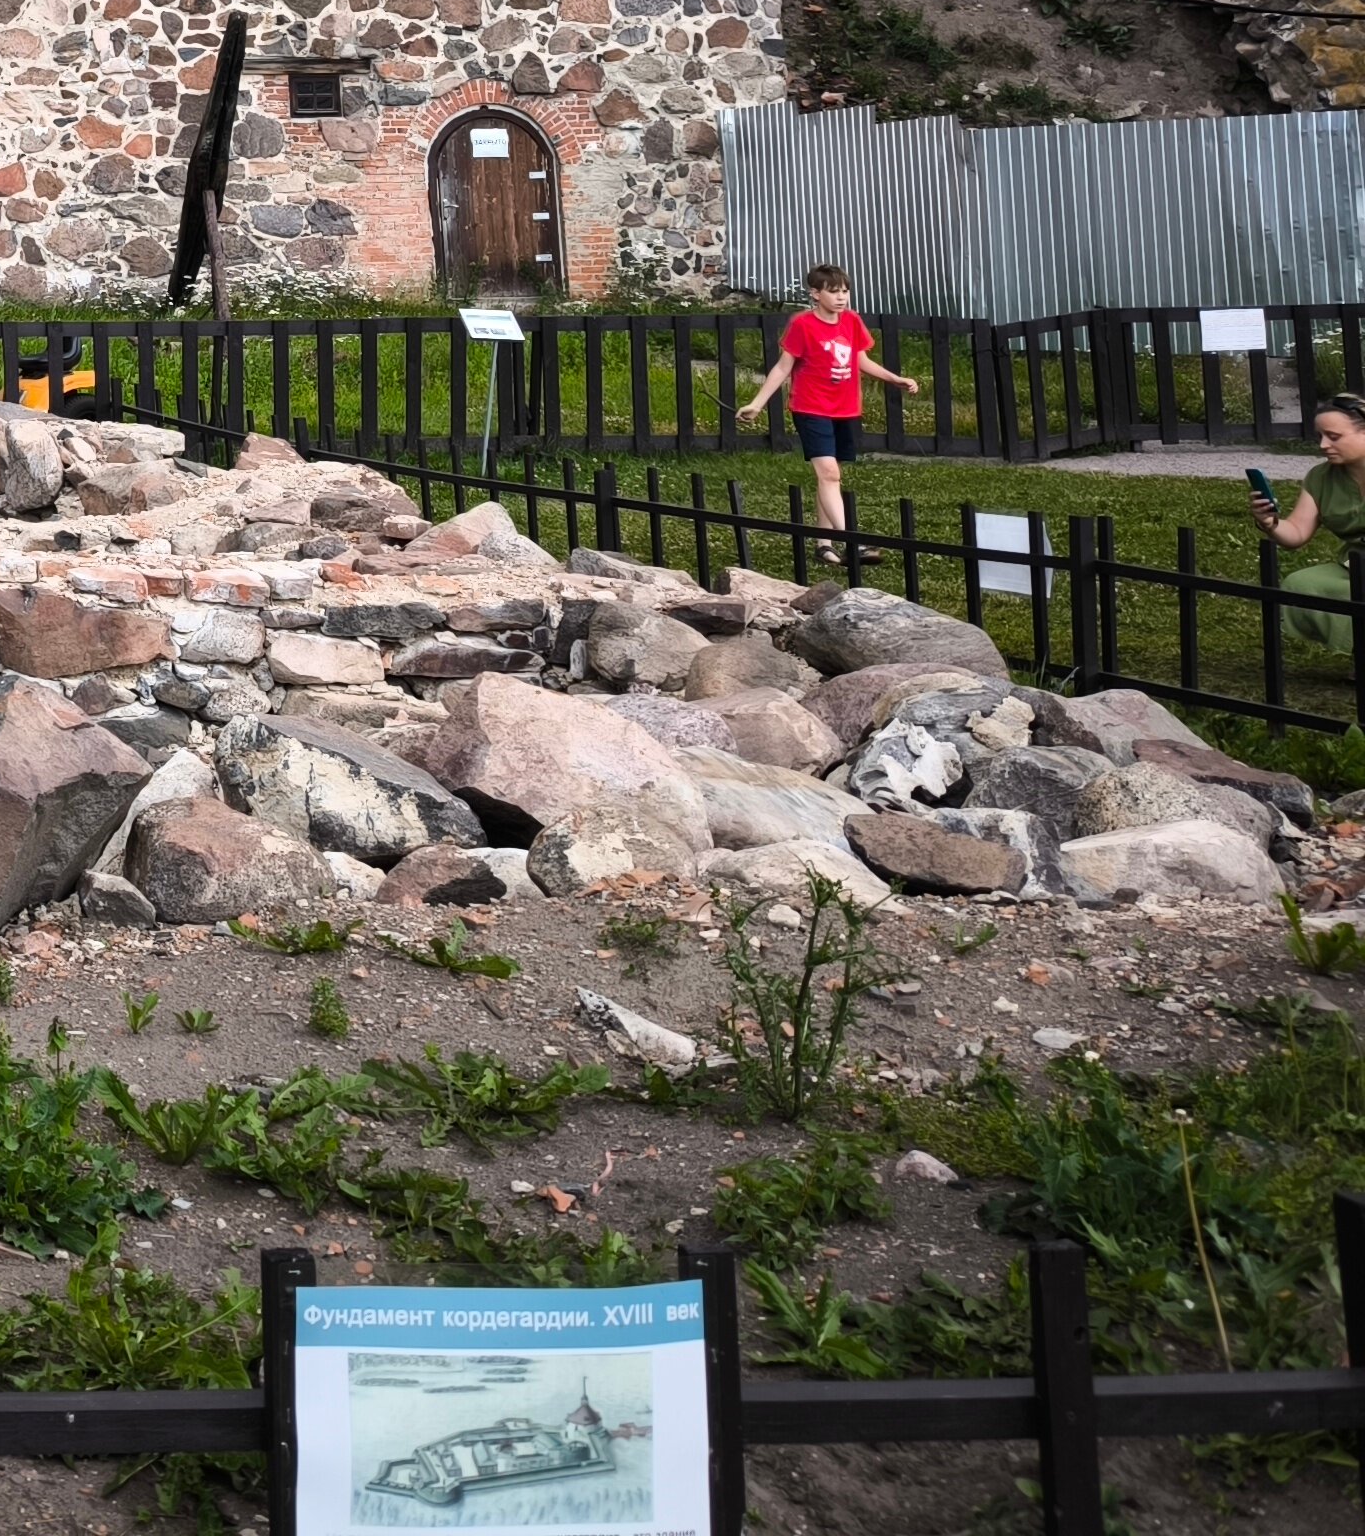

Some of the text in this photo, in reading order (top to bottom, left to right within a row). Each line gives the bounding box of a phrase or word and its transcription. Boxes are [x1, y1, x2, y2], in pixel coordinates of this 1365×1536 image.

[303, 1302, 700, 1332] Фундамент кордегардии. XVIII век
